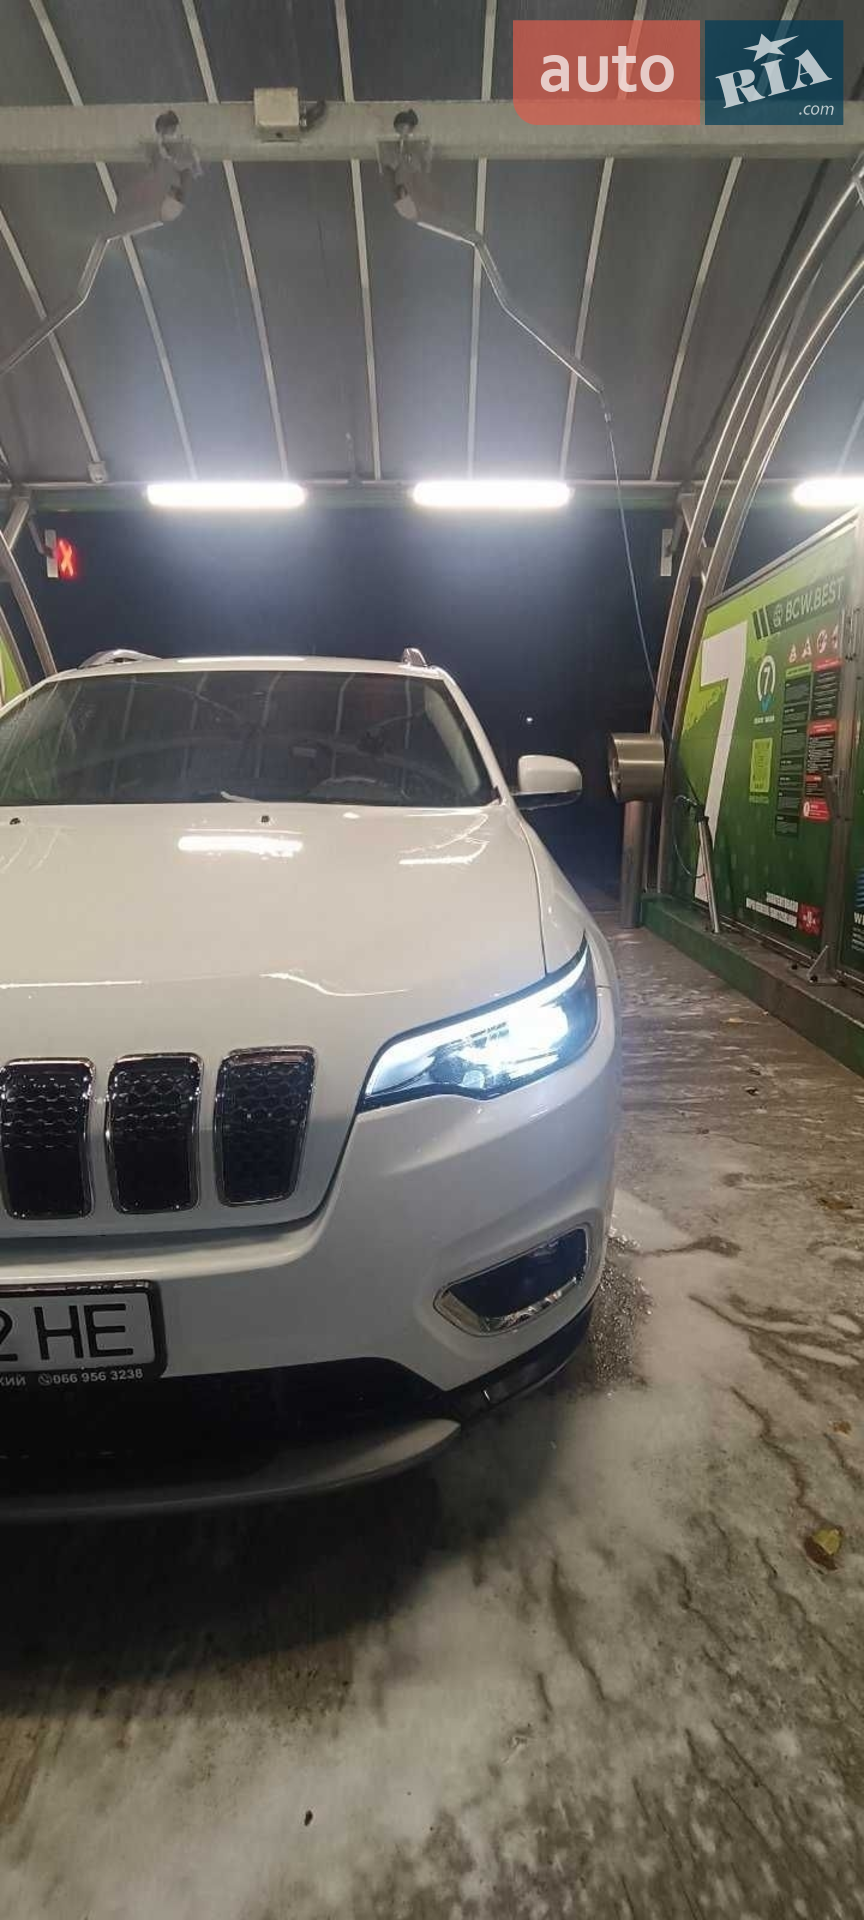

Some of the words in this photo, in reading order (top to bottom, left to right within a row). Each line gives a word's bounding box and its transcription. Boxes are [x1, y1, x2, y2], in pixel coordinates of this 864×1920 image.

[694, 620, 748, 903] 7
[34, 1303, 134, 1361] HE
[53, 1373, 78, 1385] 066
[82, 1371, 107, 1383] 956
[111, 1368, 144, 1381] 3238
